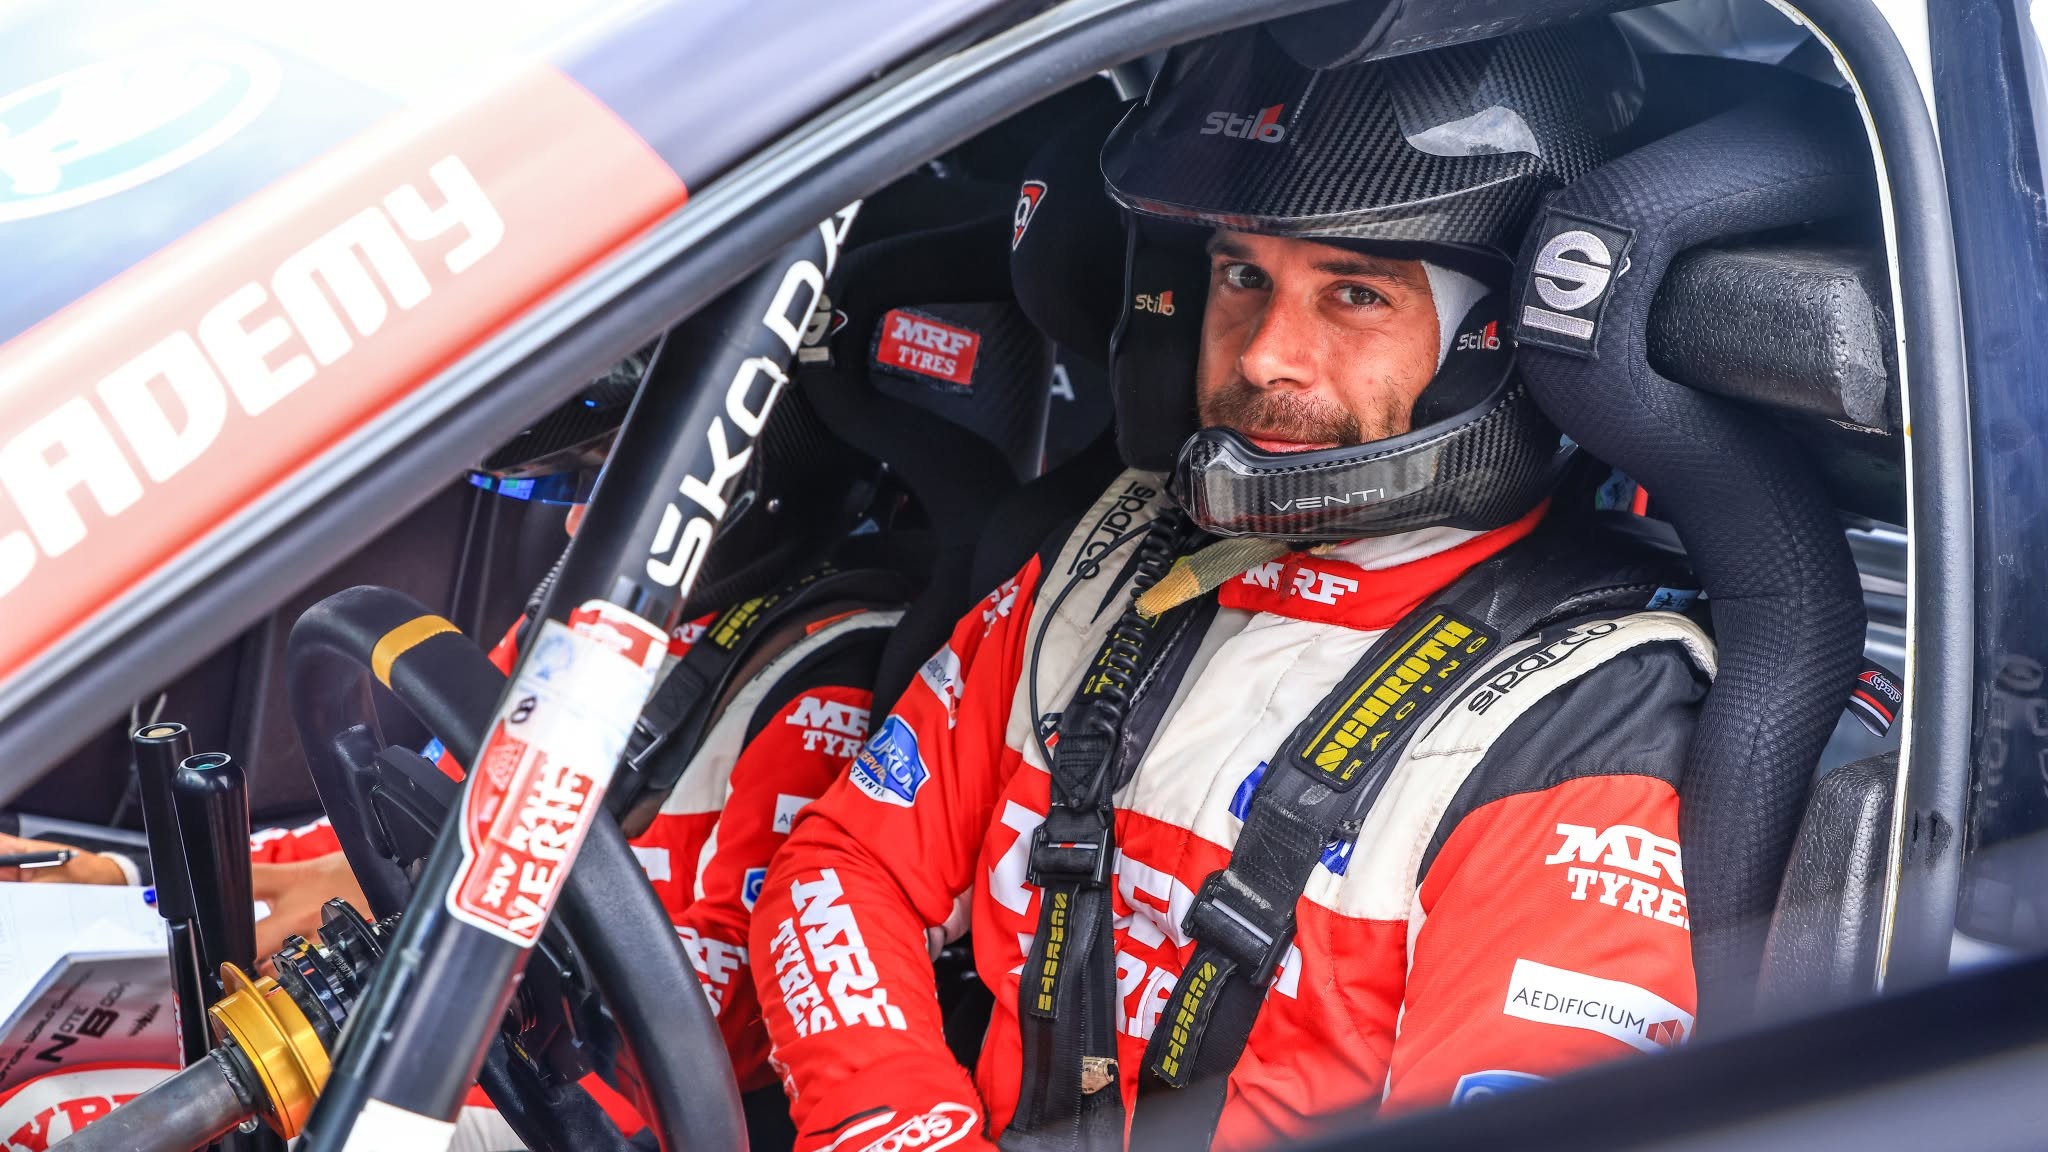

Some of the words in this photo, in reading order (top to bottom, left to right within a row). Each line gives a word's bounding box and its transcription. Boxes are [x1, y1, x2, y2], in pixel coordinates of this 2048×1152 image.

[1200, 103, 1285, 143] Stilo
[892, 316, 972, 356] MRF
[1134, 290, 1176, 317] Stilo
[0, 154, 504, 600] ADEMY
[898, 344, 958, 377] TYRES
[1269, 487, 1386, 513] VENTI
[1314, 619, 1474, 772] SCHROTH
[1545, 822, 1684, 890] MR
[1567, 866, 1690, 931] TYRE
[769, 917, 838, 1039] TYRES
[789, 867, 908, 1031] MRF
[1037, 892, 1068, 1012] SCHROTH
[1512, 986, 1646, 1035] AEDIFICIUM
